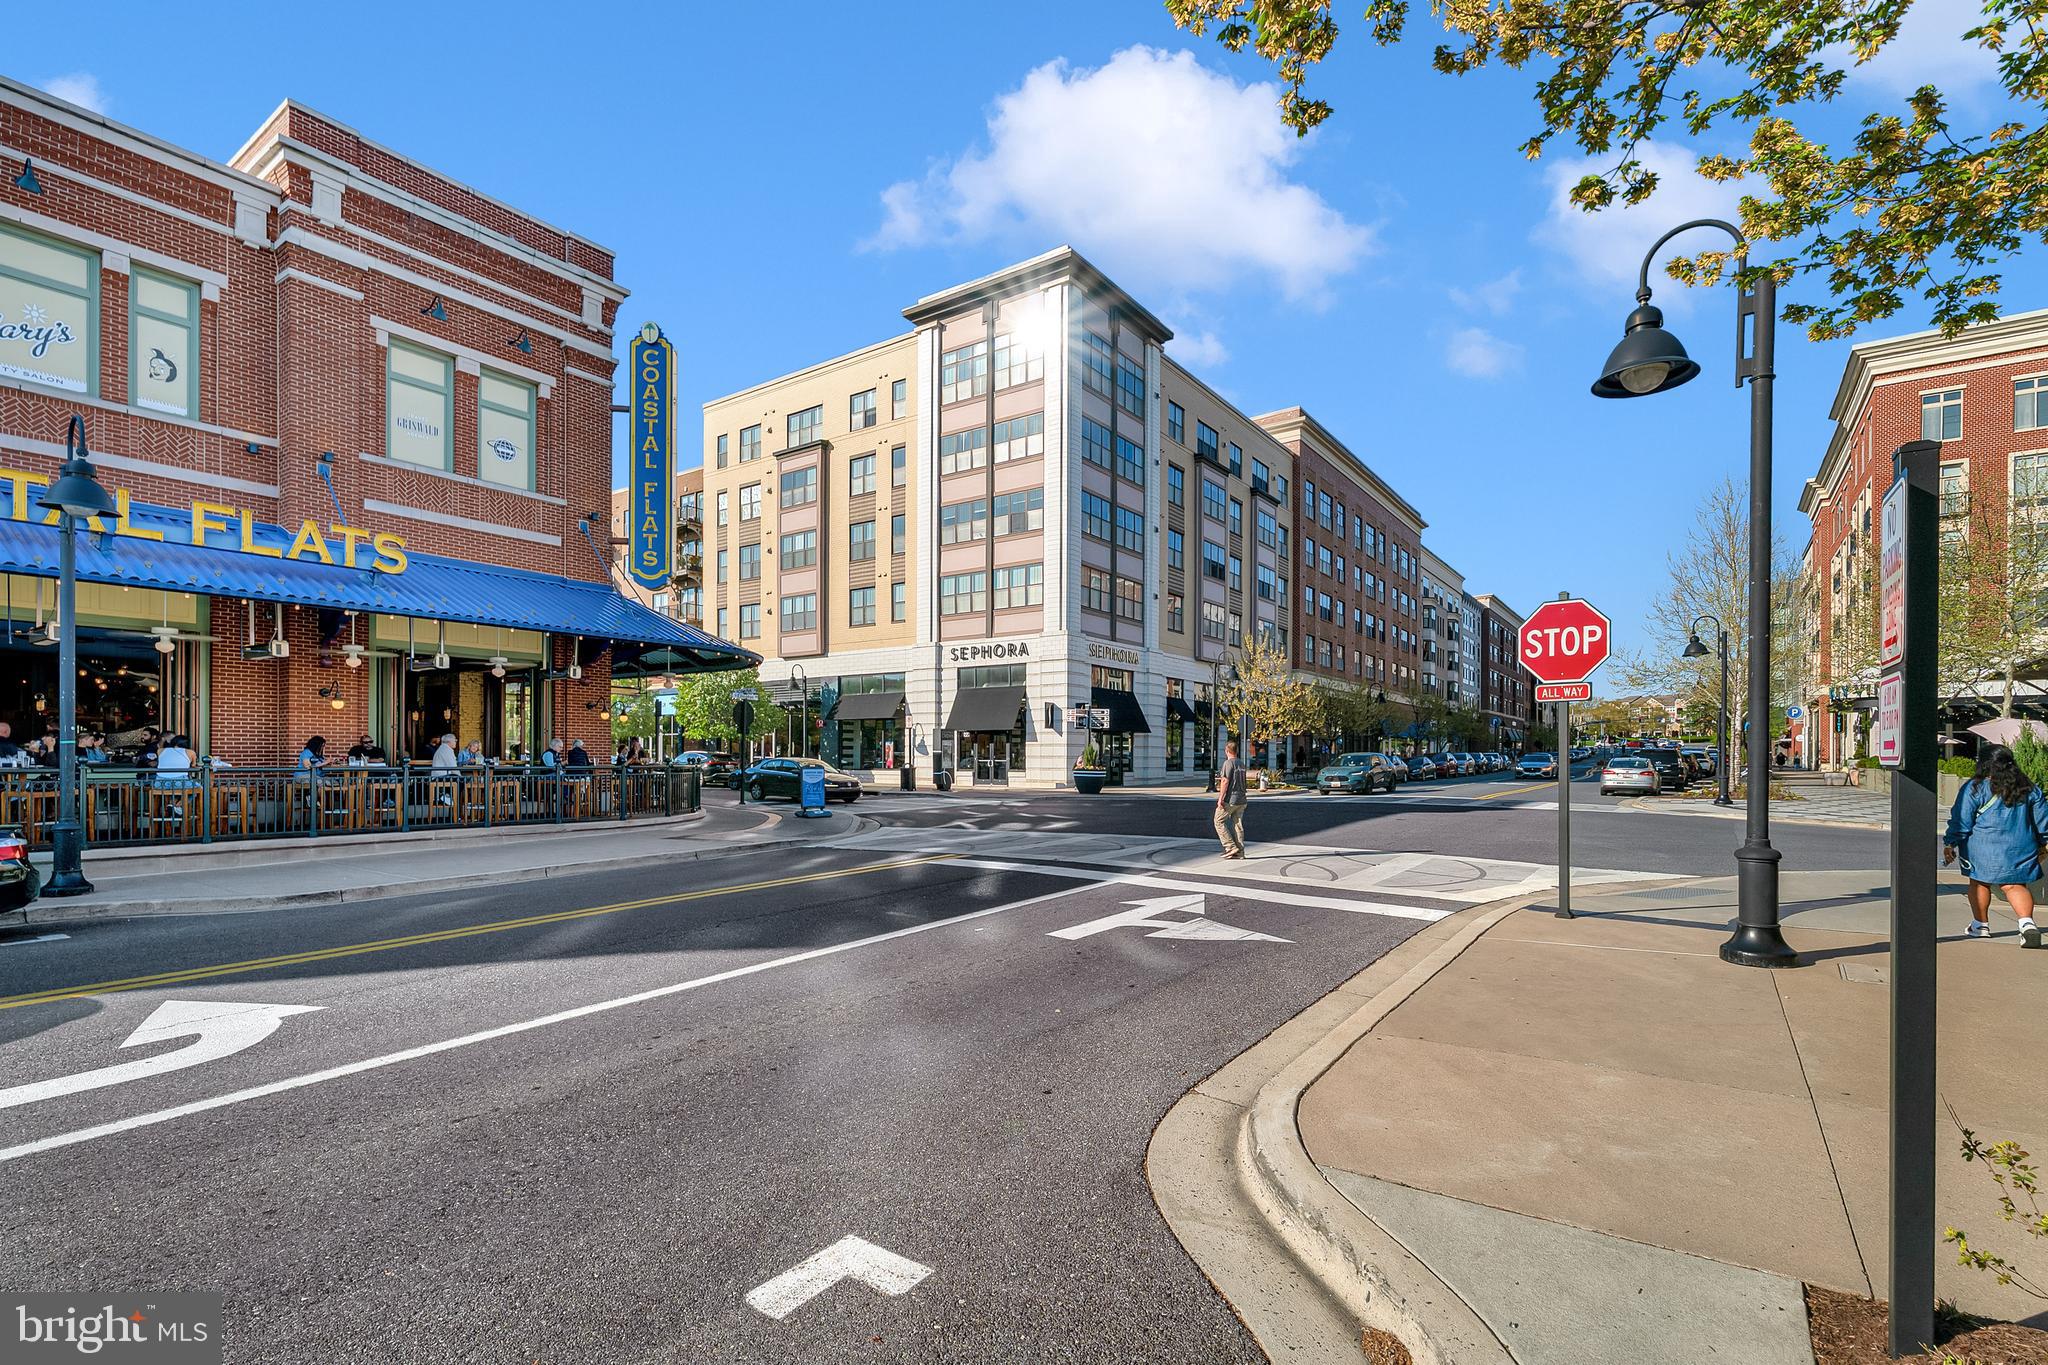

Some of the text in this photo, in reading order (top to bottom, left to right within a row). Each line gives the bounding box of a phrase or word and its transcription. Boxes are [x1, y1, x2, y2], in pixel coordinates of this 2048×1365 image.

[0, 312, 76, 358] ary's
[23, 371, 64, 385] SALON
[397, 417, 439, 437] GRISWALD
[642, 349, 660, 567] COASTAL FLATS
[1887, 504, 1897, 541] NO
[191, 500, 409, 575] FLATS
[950, 641, 1030, 662] SEPHORA
[1088, 642, 1140, 665] SEPHORA
[1524, 625, 1603, 659] STOP
[1541, 686, 1584, 698] ALL WAY
